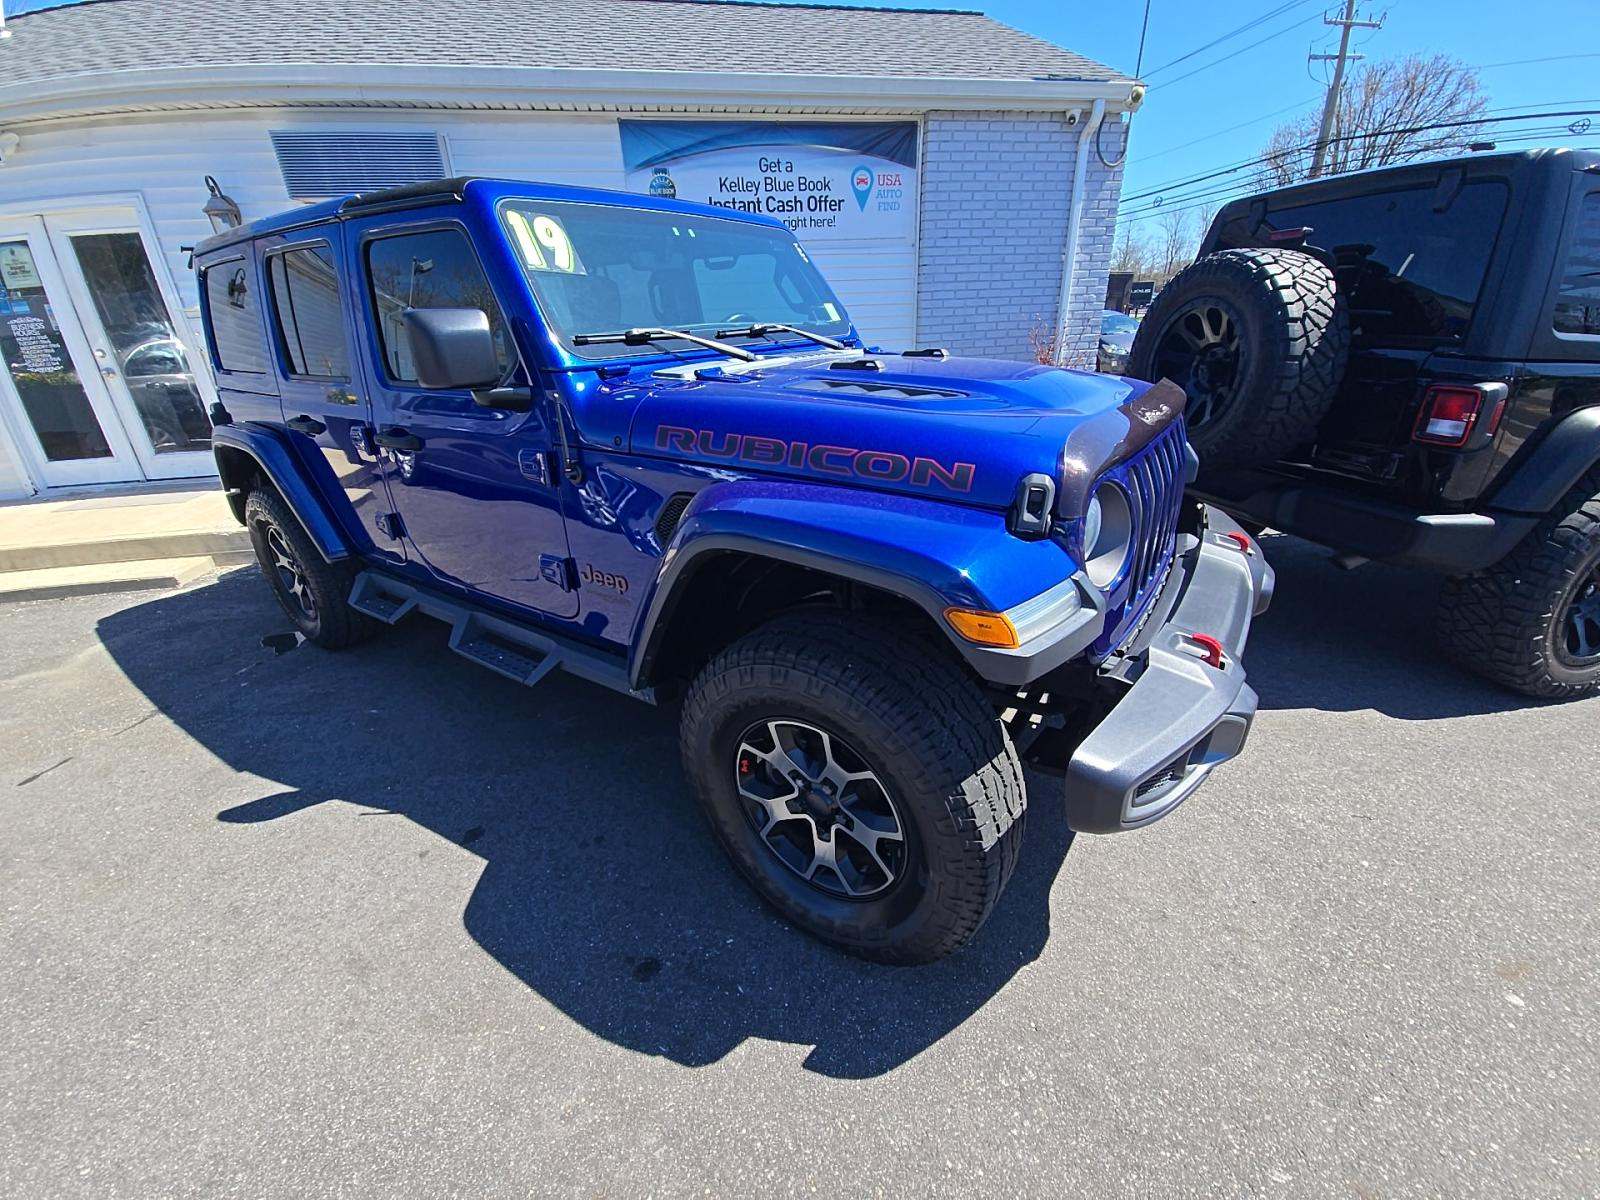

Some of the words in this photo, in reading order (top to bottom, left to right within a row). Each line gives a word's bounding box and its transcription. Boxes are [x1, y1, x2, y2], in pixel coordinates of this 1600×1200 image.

[759, 157, 782, 173] Get
[785, 161, 793, 173] a
[719, 176, 761, 196] Kelley
[764, 176, 794, 192] Blue
[798, 176, 831, 192] Book
[877, 174, 902, 186] USA
[876, 189, 902, 199] AUTO
[766, 195, 802, 213] Cash
[807, 195, 845, 212] Offer
[878, 201, 900, 211] FIND
[783, 216, 807, 231] right
[809, 215, 836, 228] here!
[506, 210, 575, 273] 19
[654, 424, 976, 493] RUBICON
[580, 563, 629, 595] Jeep
